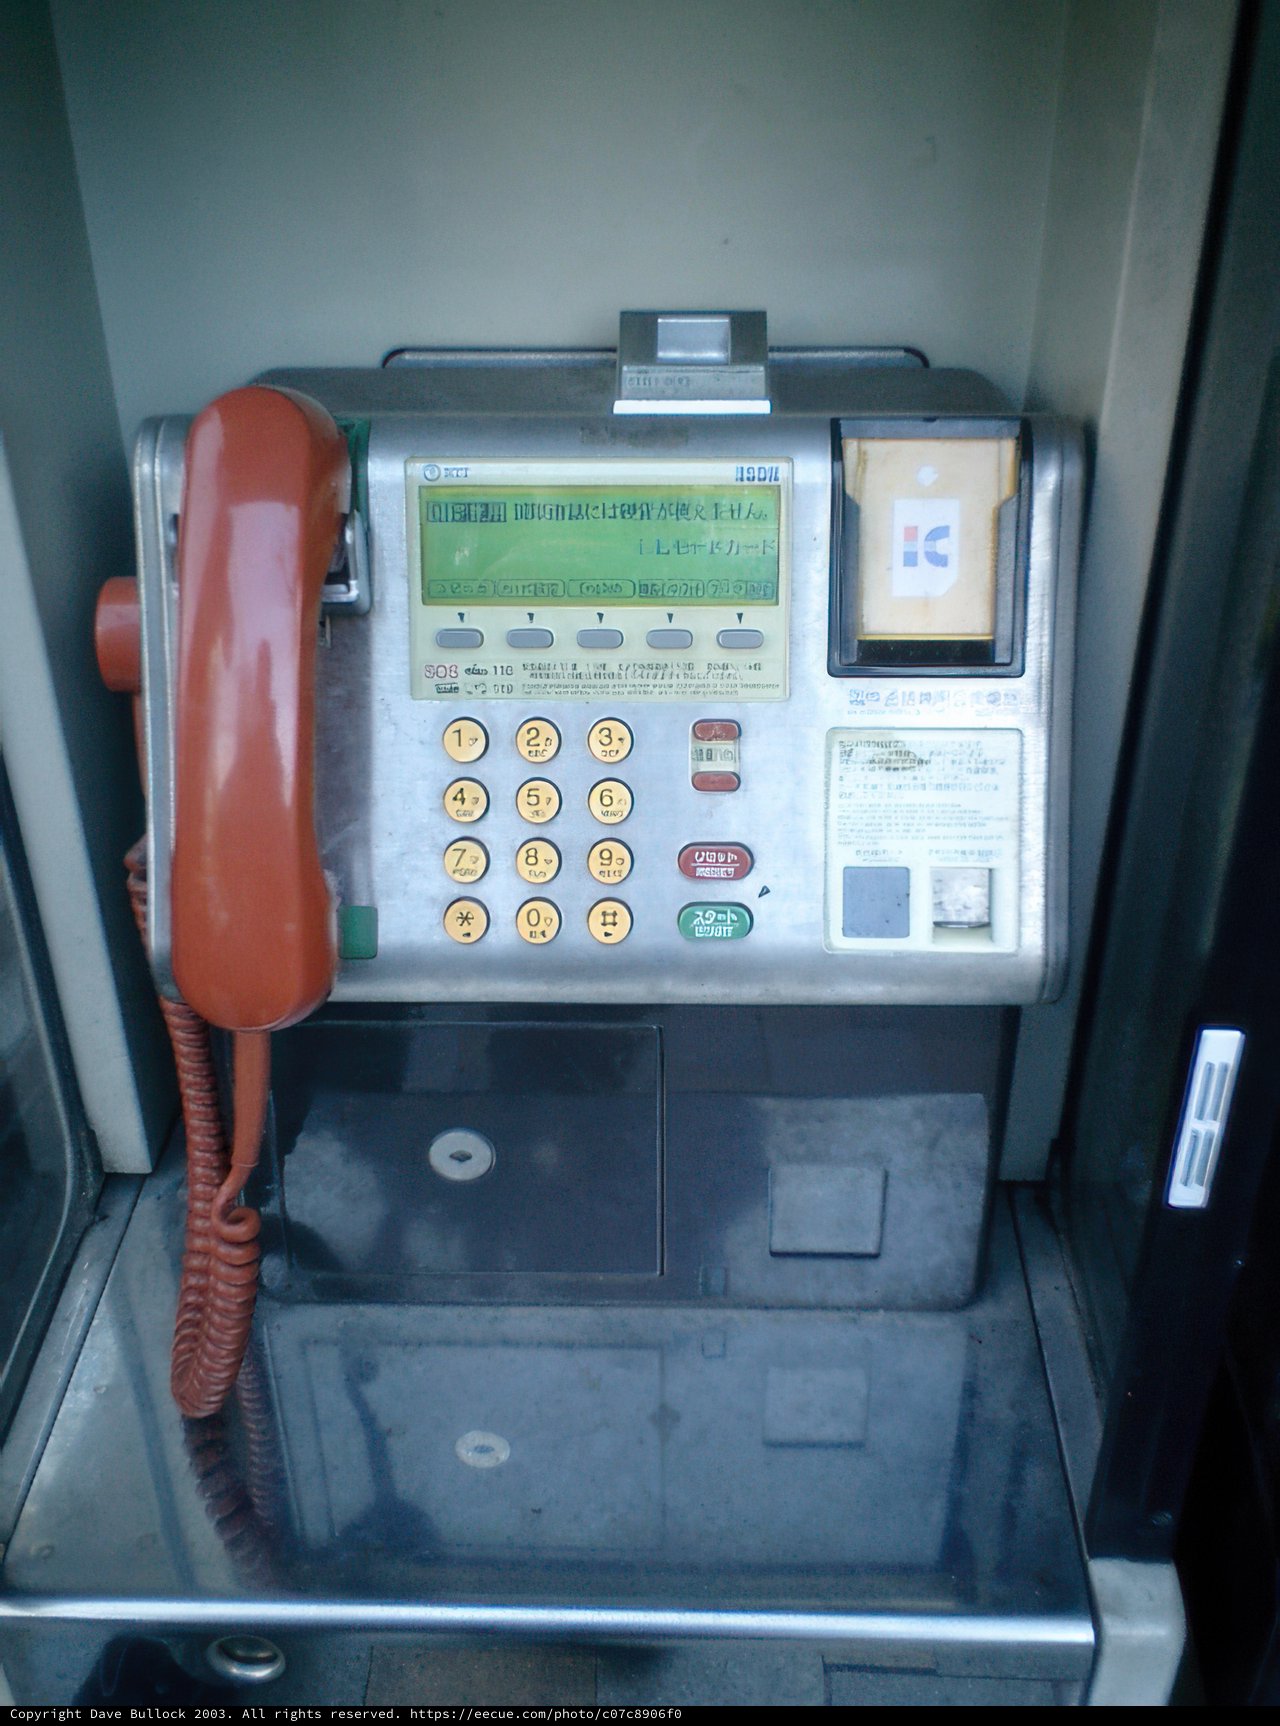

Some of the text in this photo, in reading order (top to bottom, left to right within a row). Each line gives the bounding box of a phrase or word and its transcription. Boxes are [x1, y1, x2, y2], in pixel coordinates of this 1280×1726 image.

[903, 525, 951, 567] IC
[452, 728, 462, 747] 1
[526, 727, 541, 747] 2
[598, 727, 613, 746] 3
[452, 787, 466, 806] 4
[526, 788, 540, 806] 5
[599, 788, 614, 807] 6
[452, 848, 467, 867] 7
[525, 847, 539, 866] 8
[599, 848, 613, 866] 9
[526, 908, 541, 927] 0
